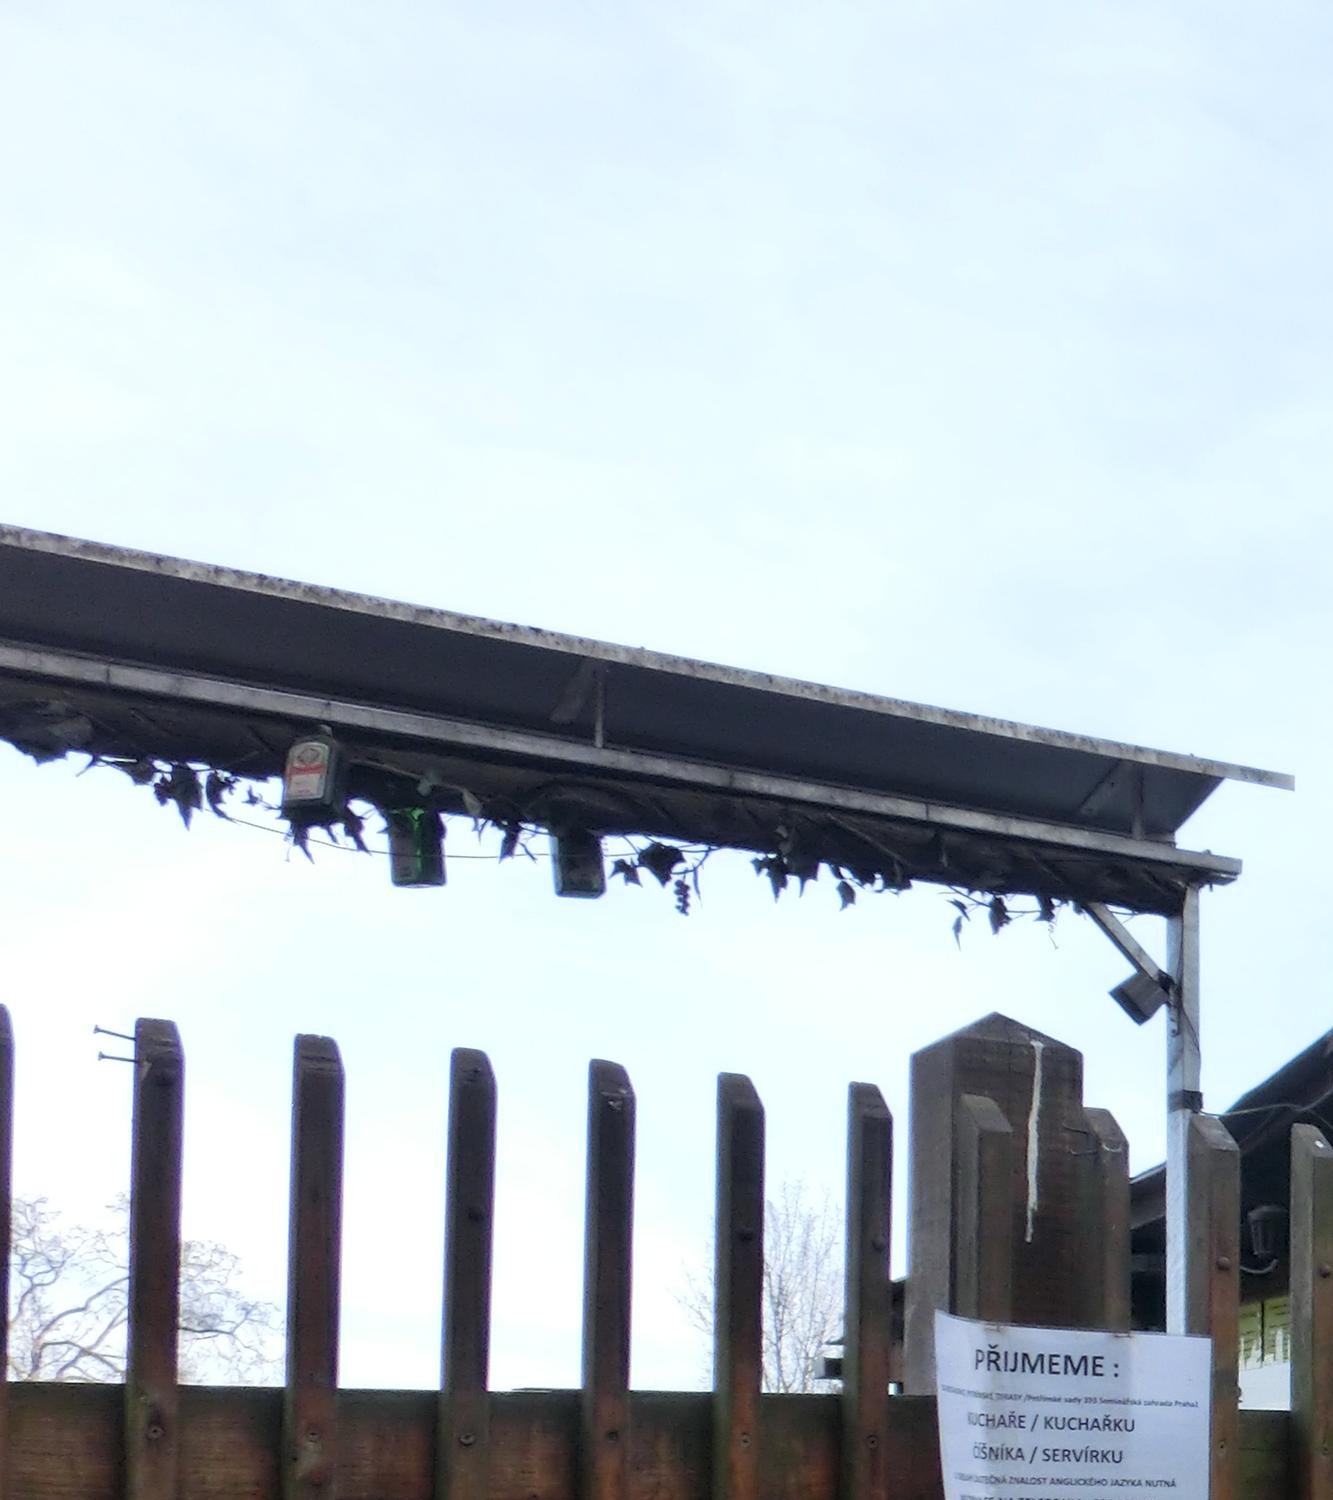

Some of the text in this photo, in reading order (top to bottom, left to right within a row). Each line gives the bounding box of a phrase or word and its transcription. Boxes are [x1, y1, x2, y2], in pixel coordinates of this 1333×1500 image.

[975, 1344, 1104, 1377] PŘIJMEME
[1044, 1414, 1135, 1432] KUCHAŘKU
[1042, 1446, 1123, 1463] SERVÍRKU
[1009, 1476, 1047, 1485] ZNALOST
[1145, 1478, 1177, 1488] NUTNÁ
